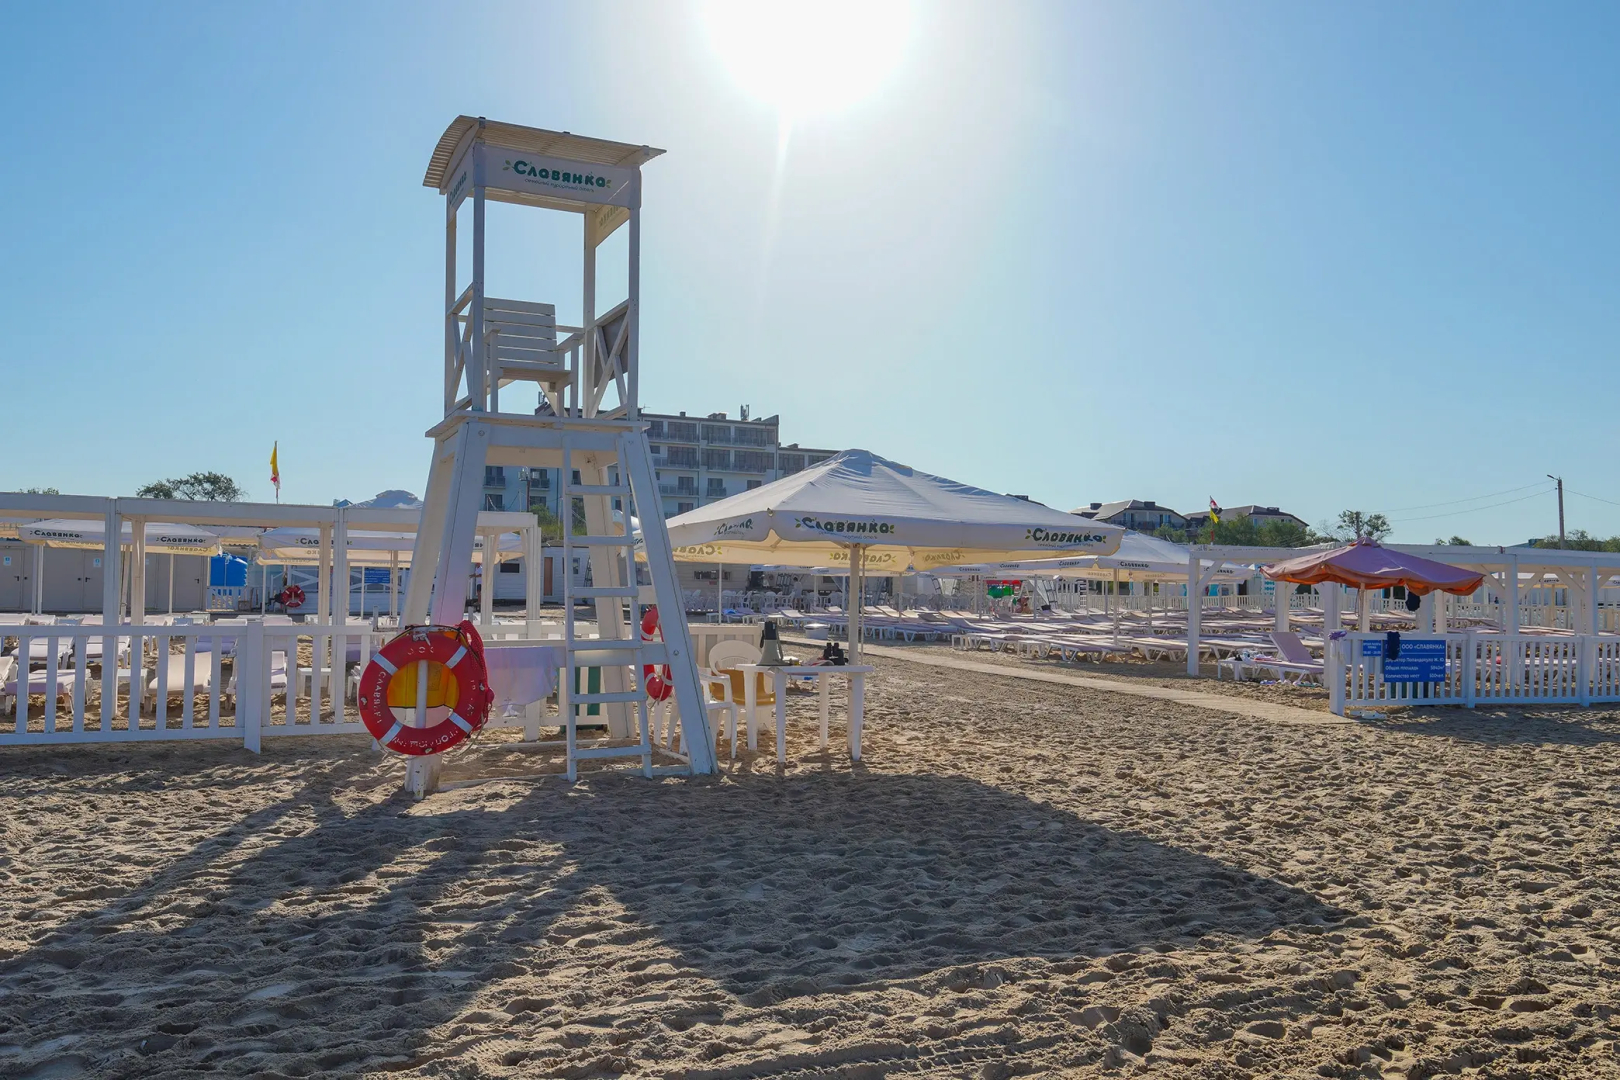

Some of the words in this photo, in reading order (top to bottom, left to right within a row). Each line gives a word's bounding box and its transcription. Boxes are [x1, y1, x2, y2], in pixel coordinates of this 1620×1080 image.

[513, 160, 606, 188] Славянка
[801, 517, 889, 534] Славянка
[34, 530, 80, 538] Славянка
[160, 536, 204, 544] Славянка
[1031, 528, 1103, 543] Славянка
